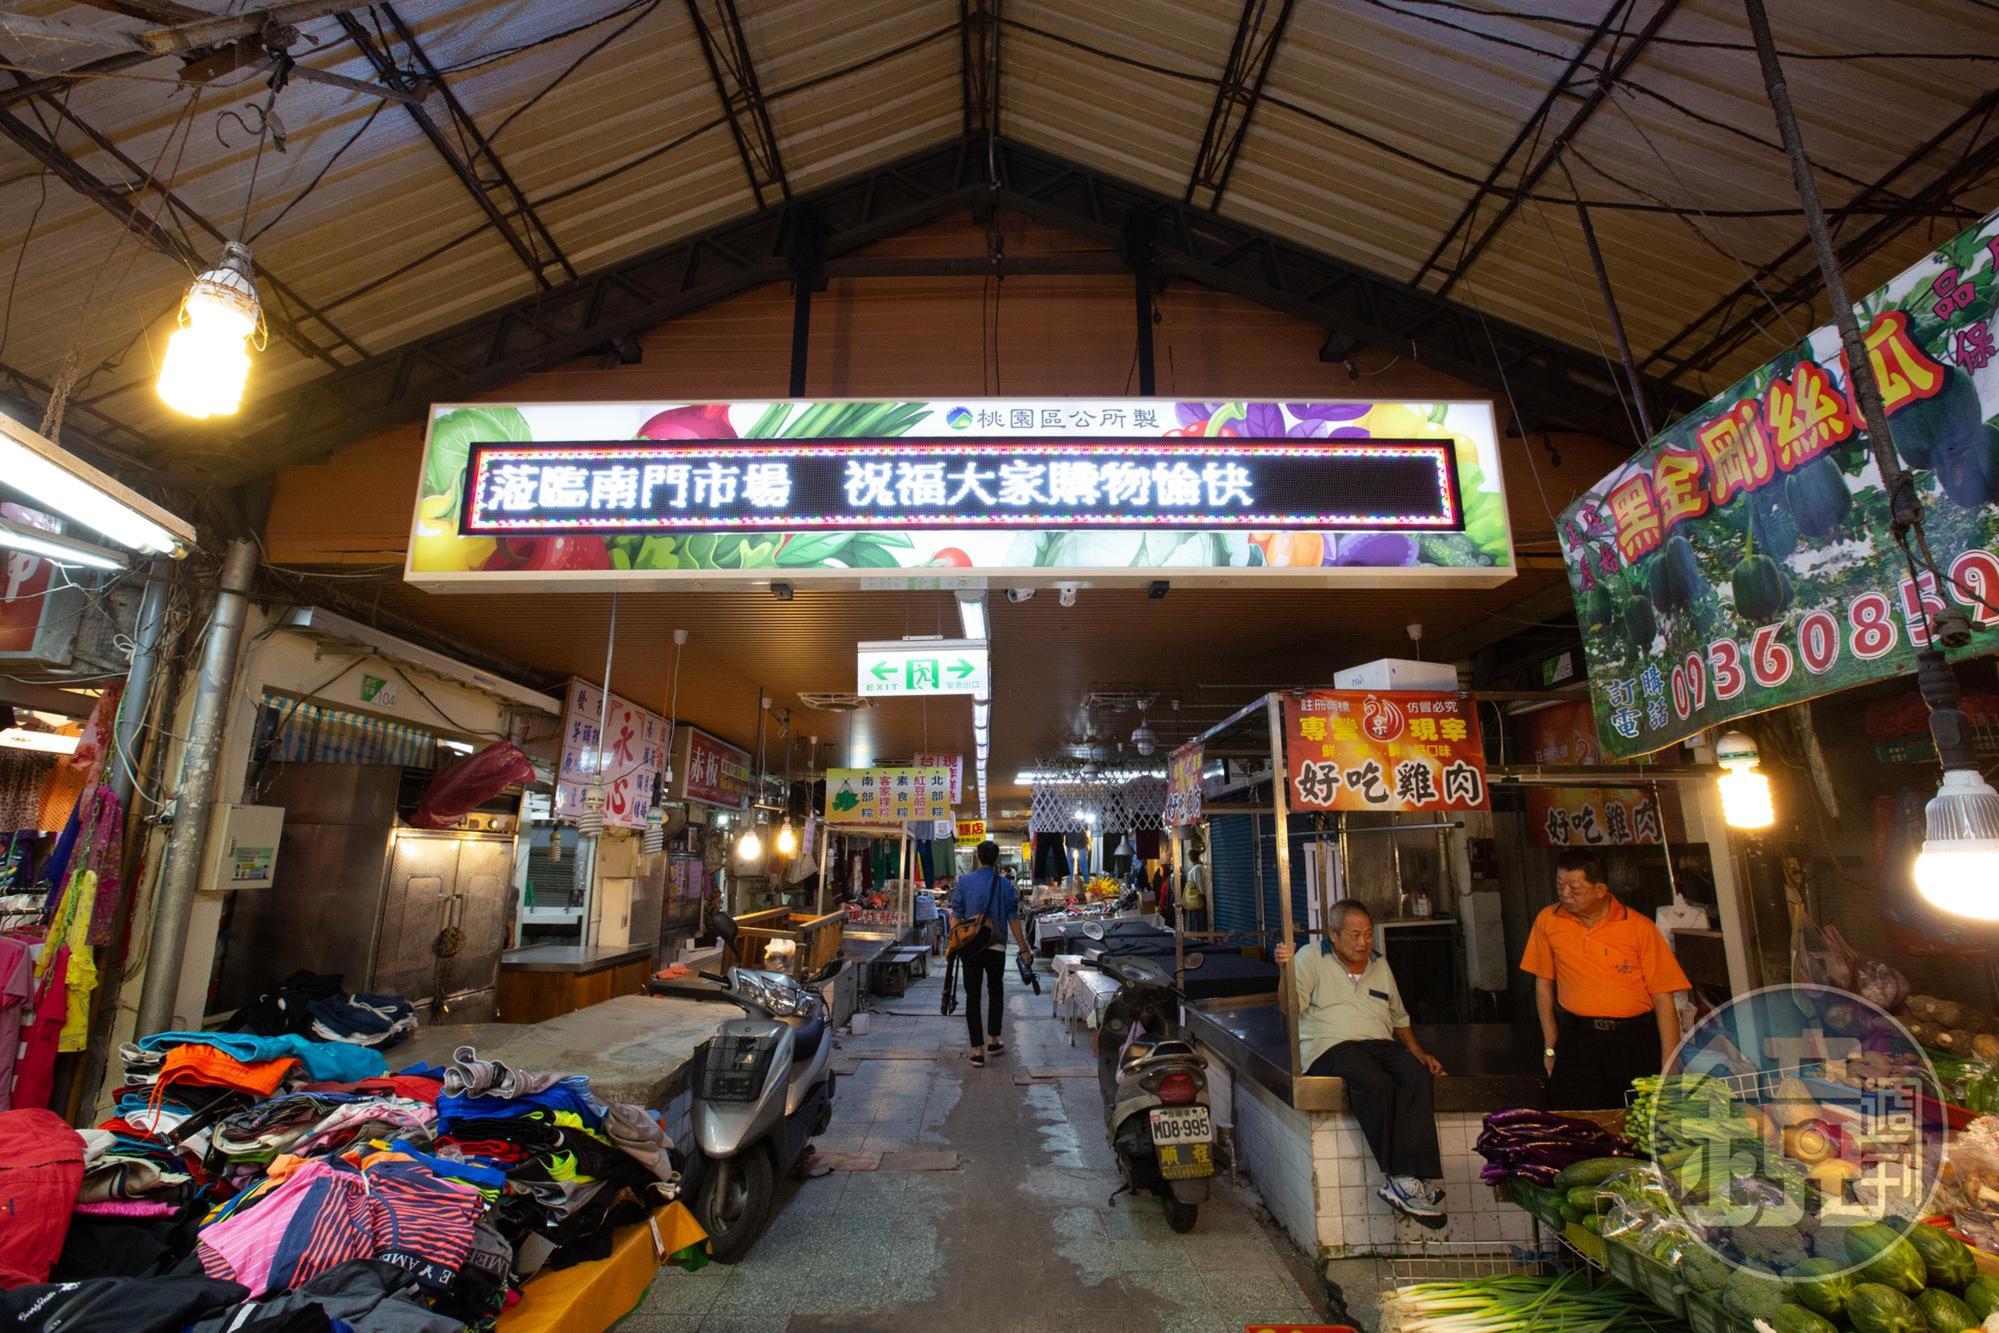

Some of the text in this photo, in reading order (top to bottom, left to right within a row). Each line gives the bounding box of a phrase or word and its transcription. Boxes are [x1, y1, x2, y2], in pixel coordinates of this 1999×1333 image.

[977, 408, 1160, 429] 桃園區公所製
[1607, 311, 1944, 562] 黑金剛絲瓜
[487, 460, 1254, 511] 蒞臨南門市場 祝福大家購物愉快
[378, 691, 395, 706] 104
[866, 683, 898, 691] EXIT
[1608, 663, 1664, 707] 訂購
[1409, 717, 1467, 742] 現宰
[1610, 697, 1668, 738] 電話
[861, 776, 874, 818] 南部粽
[896, 776, 909, 818] 素食粽
[931, 775, 944, 817] 北部粽
[1296, 759, 1483, 806] 好吃雞肉
[1545, 801, 1664, 845] 好吃雞肉
